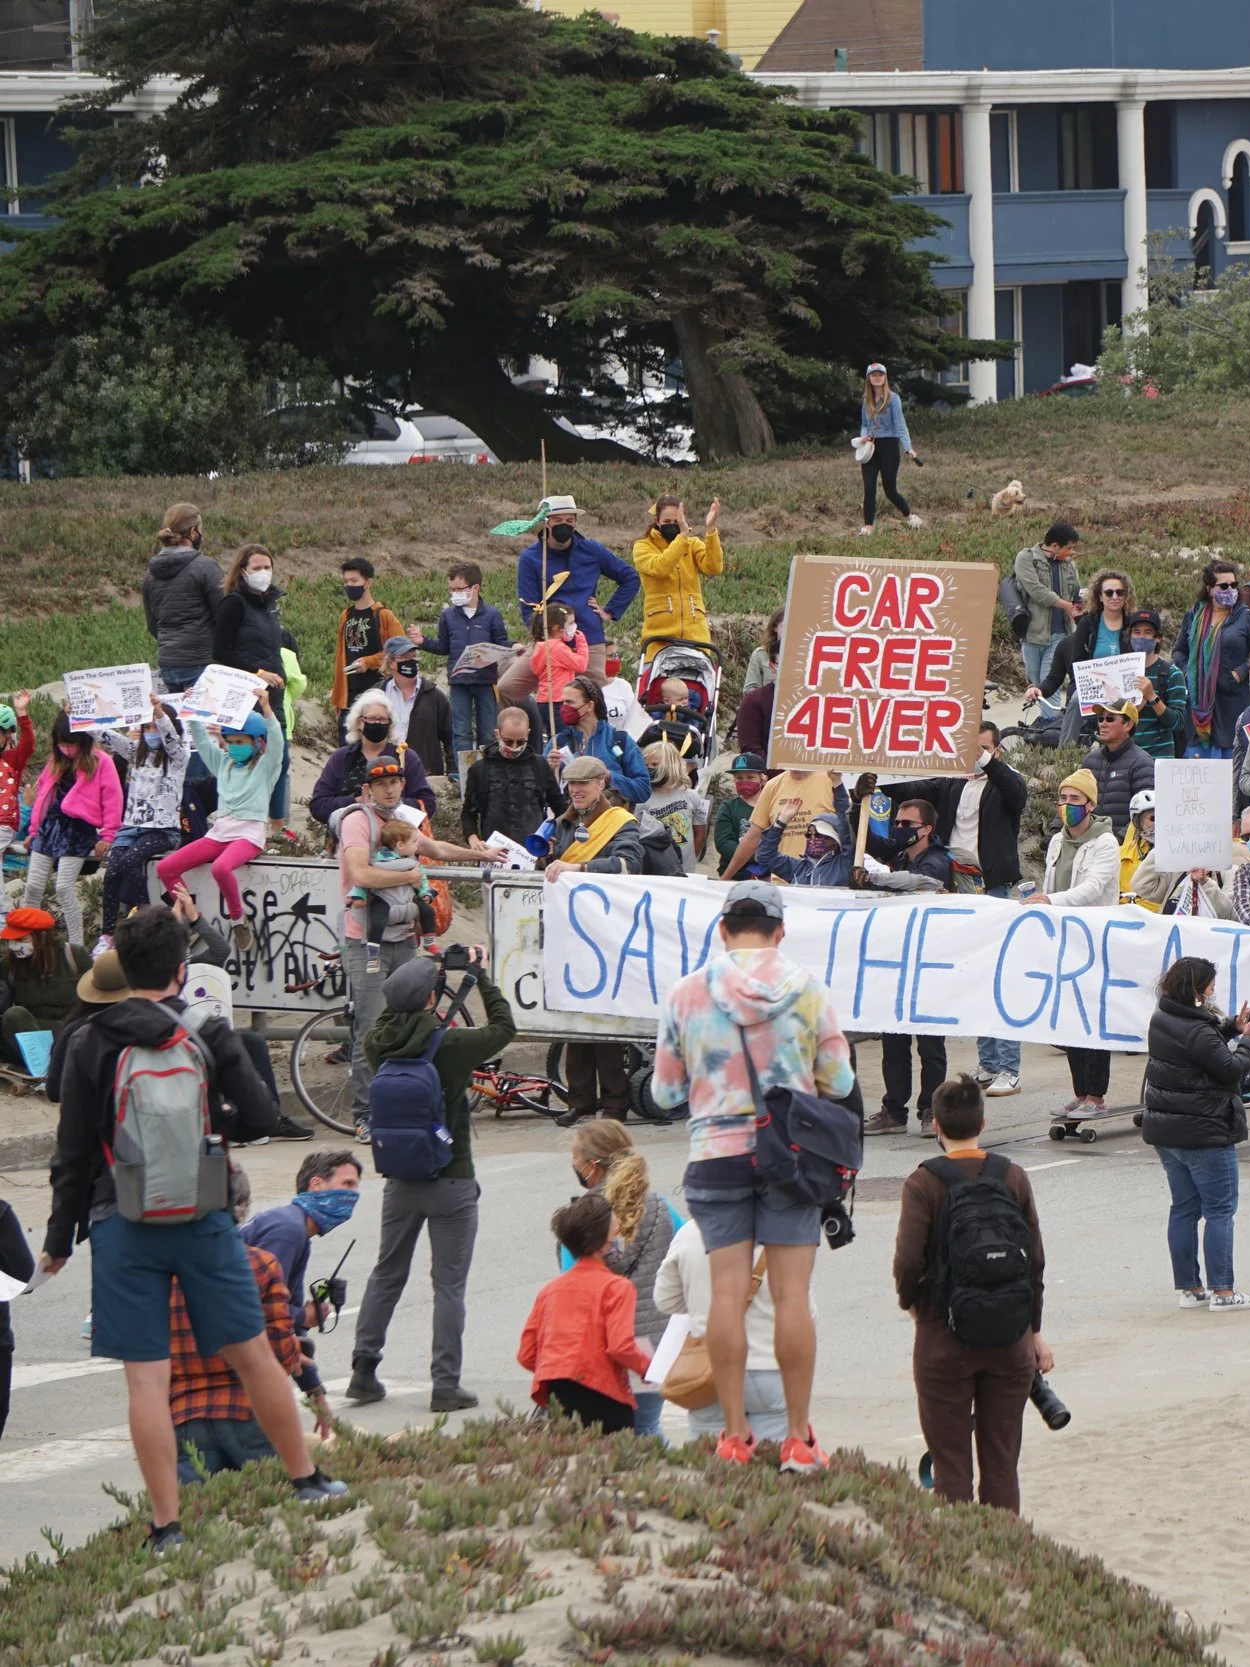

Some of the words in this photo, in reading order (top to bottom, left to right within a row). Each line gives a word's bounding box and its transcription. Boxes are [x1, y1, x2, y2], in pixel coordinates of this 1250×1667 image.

[833, 572, 944, 632] CAR
[805, 631, 956, 695] FREE
[1119, 656, 1141, 664] Walkway
[68, 674, 85, 682] Save
[85, 672, 98, 680] The
[98, 670, 115, 678] Great
[115, 667, 145, 677] Walkway
[785, 693, 964, 759] 4EVER
[1171, 765, 1213, 785] PEOPLE
[1182, 787, 1201, 802] NOT
[1175, 803, 1206, 817] CARS
[1164, 823, 1184, 836] SAVE
[515, 849, 530, 861] Great
[817, 906, 976, 1025] THE
